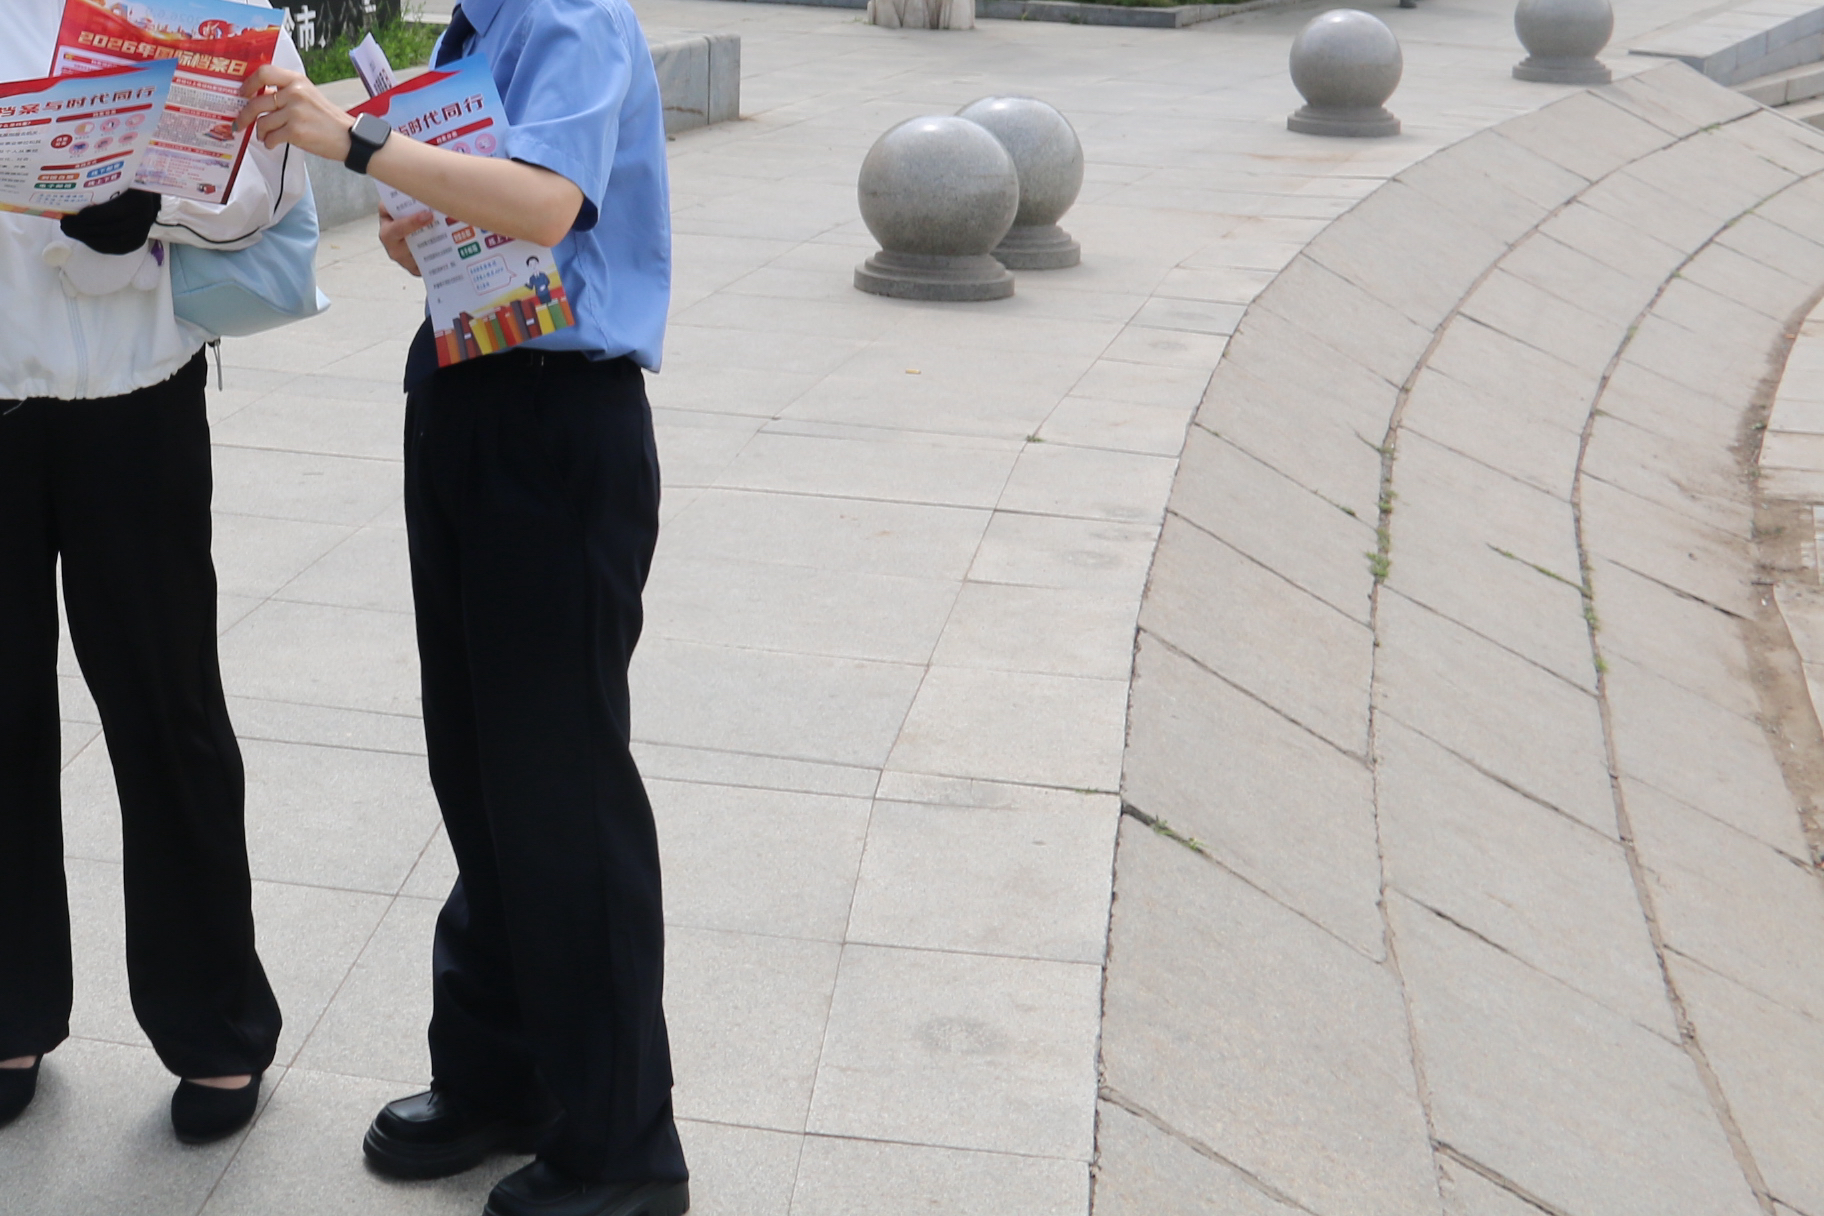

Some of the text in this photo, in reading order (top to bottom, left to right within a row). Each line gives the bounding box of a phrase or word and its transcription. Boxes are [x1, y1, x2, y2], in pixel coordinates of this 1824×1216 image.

[77, 30, 249, 76] 2026年国际档案日
